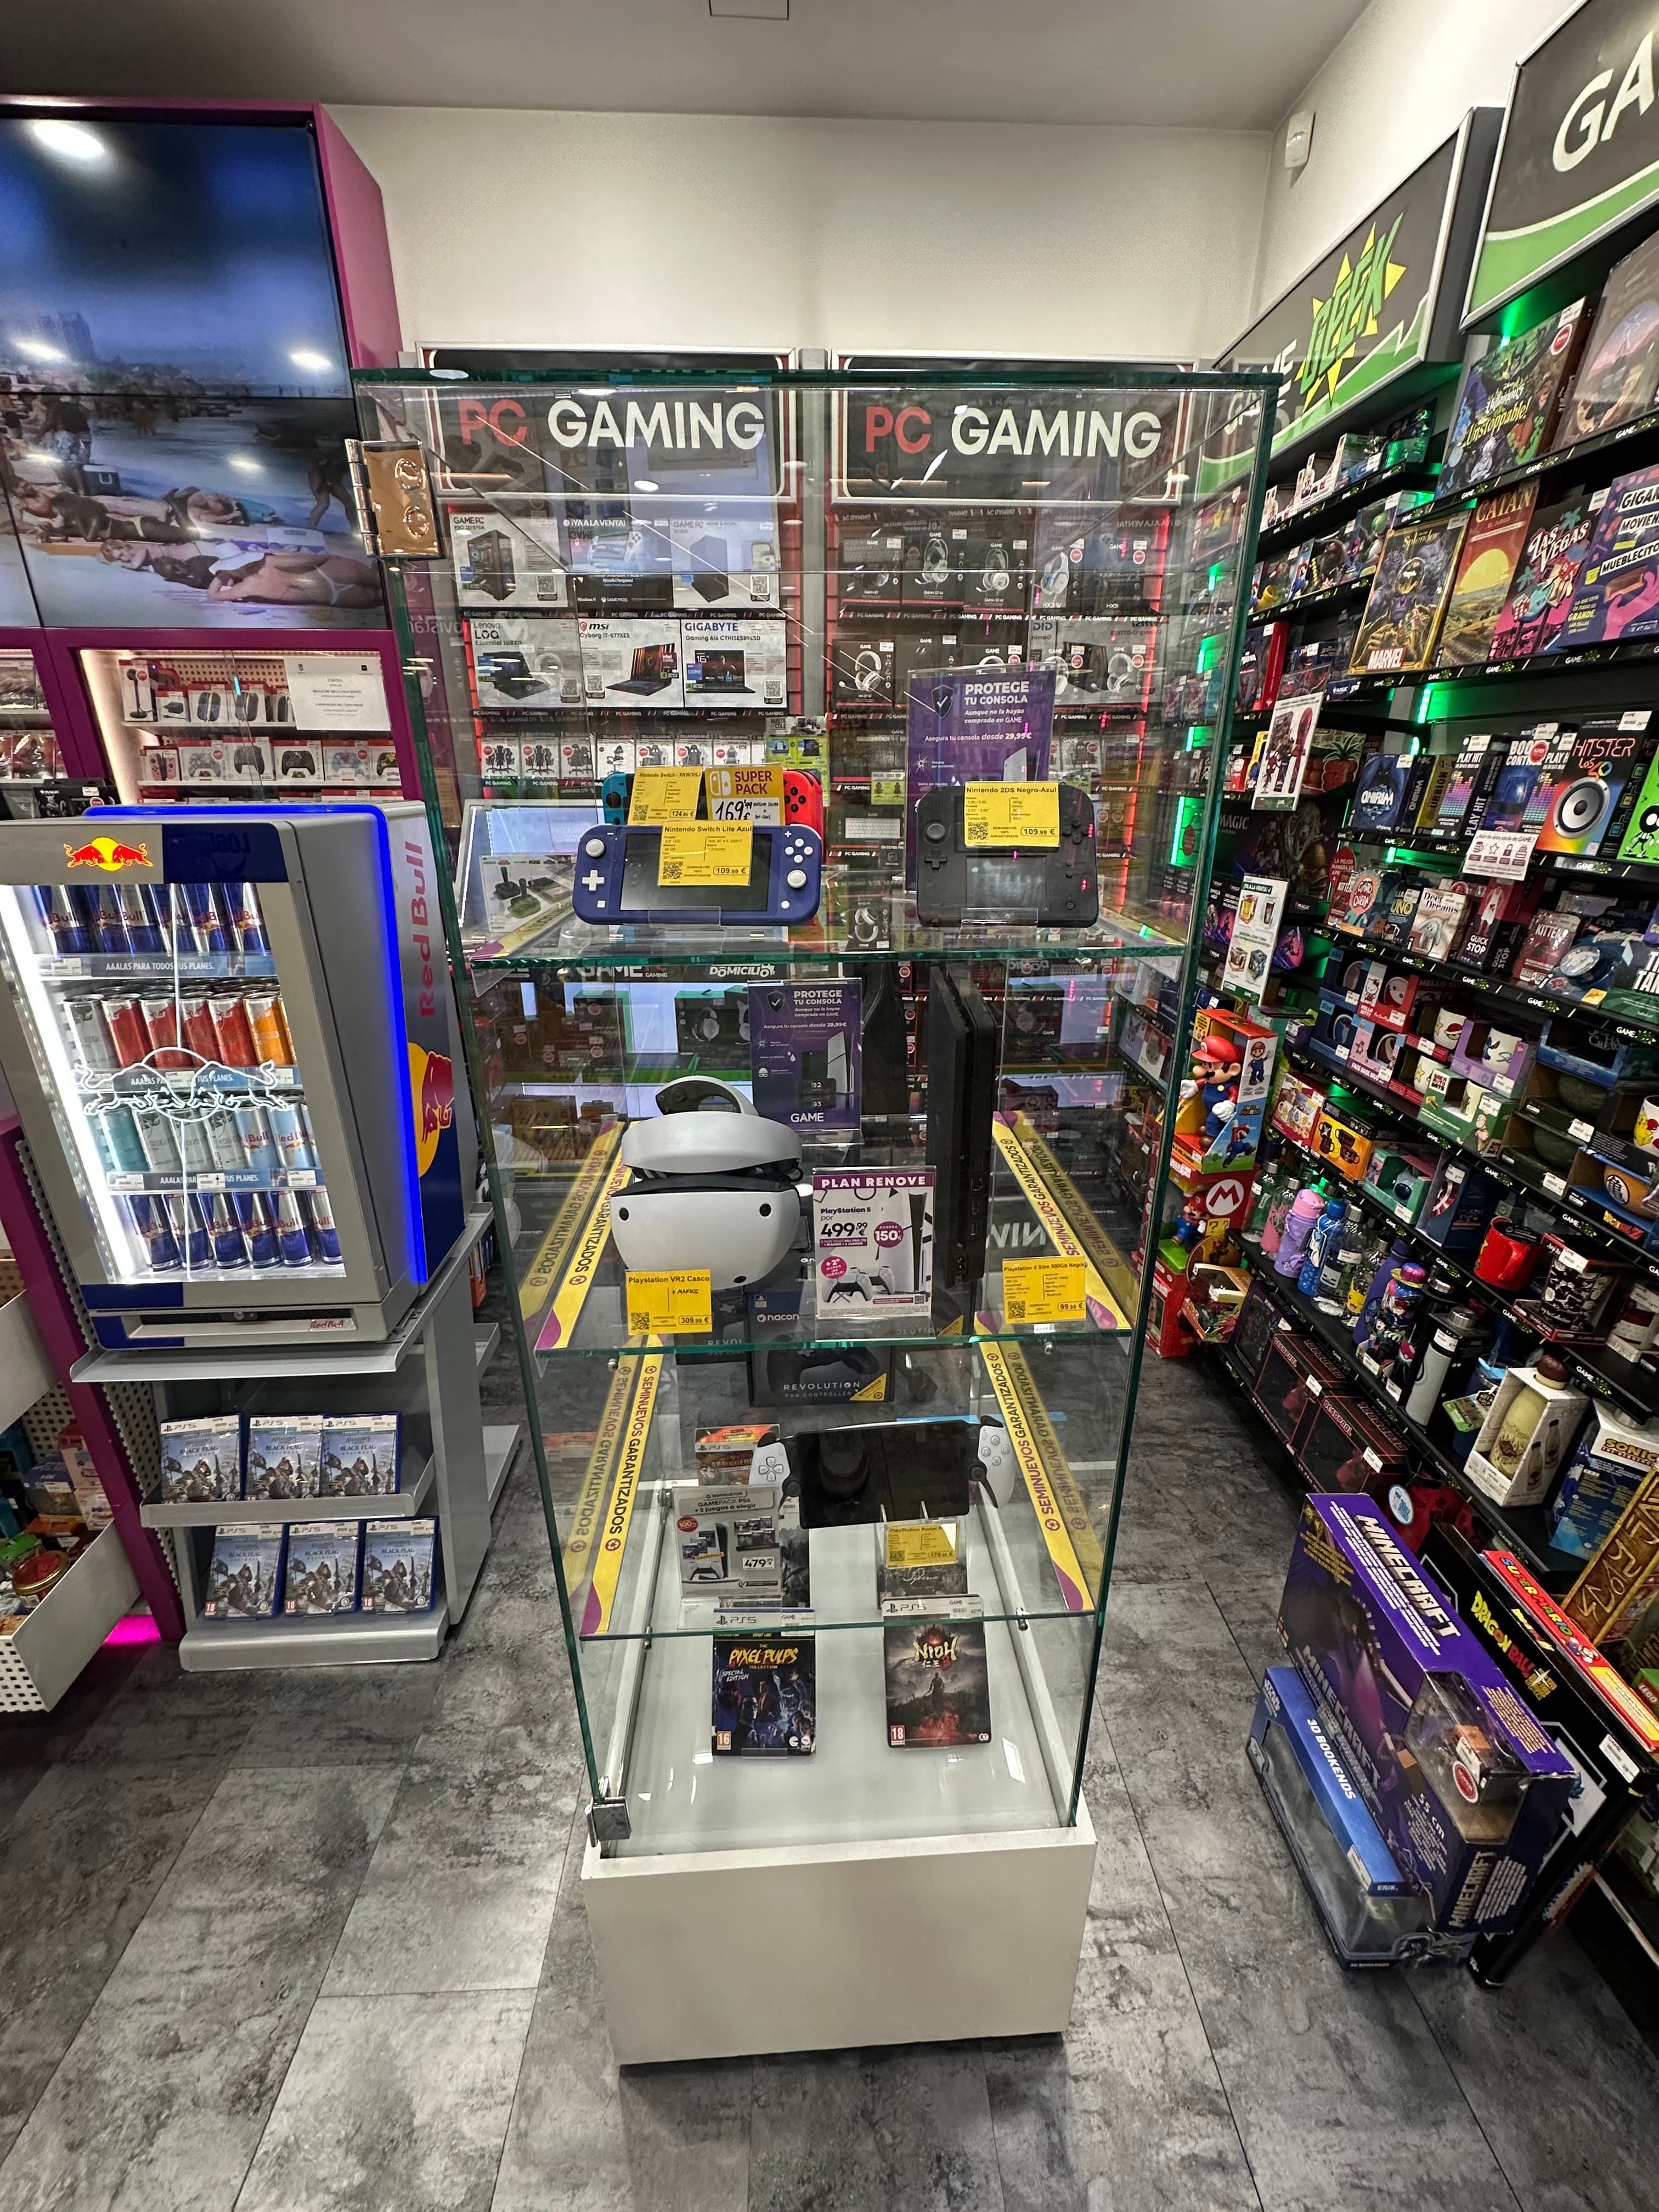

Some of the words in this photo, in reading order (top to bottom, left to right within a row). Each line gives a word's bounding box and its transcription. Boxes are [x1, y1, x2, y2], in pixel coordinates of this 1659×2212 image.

[459, 399, 527, 447] PC
[548, 399, 765, 449] GAMING
[1467, 396, 1532, 449] Unstoppable!
[865, 406, 932, 453] PC
[951, 408, 1161, 458] GAMING
[1615, 426, 1637, 439] GAME
[1526, 462, 1543, 475] GAME
[1476, 488, 1534, 523] CATAN
[473, 621, 500, 629] Lenovo
[589, 623, 610, 631] msi
[685, 622, 738, 631] GIGABYTE
[475, 630, 500, 640] LOQ
[1367, 647, 1406, 669] MARVEL
[964, 681, 1029, 695] PROTEGE
[964, 697, 977, 706] TU
[979, 695, 1029, 705] CONSOLA
[1005, 732, 1032, 741] 29,99€
[1572, 737, 1636, 757] HITSTER
[1457, 753, 1472, 763] PLAY
[1472, 752, 1484, 762] HIT
[735, 770, 772, 783] SUPER
[736, 783, 769, 795] PACK
[1361, 790, 1394, 805] ONIRIM
[1576, 862, 1594, 871] GAME
[405, 840, 428, 927] Bull
[1470, 934, 1489, 946] QUICK
[1465, 941, 1487, 955] STOP
[133, 962, 151, 970] PARA
[152, 962, 174, 970] TODOS
[189, 962, 215, 970] PLANES.
[411, 934, 437, 1017] Red
[1463, 977, 1476, 985] GAME
[794, 990, 843, 998] PROTEGE
[1527, 997, 1544, 1008] GAME
[1616, 1026, 1637, 1039] GAME
[791, 1112, 824, 1122] GAME
[1010, 1145, 1047, 1200] GARANTIZADOS
[821, 1178, 861, 1188] PLAN
[866, 1176, 926, 1187] RENOVE
[1037, 1201, 1080, 1256] SEMINUEVOS
[874, 1230, 898, 1242] 150
[768, 1312, 799, 1321] nacon
[1576, 1365, 1594, 1383] GAME
[784, 1381, 860, 1391] REVOLUTION
[632, 1376, 654, 1437] SEMINUEVOS
[996, 1362, 1027, 1438] GARANTIZADOS
[180, 1446, 200, 1454] BLACK
[201, 1445, 219, 1453] FLAG
[1605, 1437, 1658, 1462] SONIC
[1017, 1440, 1054, 1515] SEMINUEVOS
[610, 1438, 641, 1534] GARANTIZADOS
[698, 1499, 737, 1508] GAMEPACK
[705, 1505, 729, 1514] juegos
[1354, 1514, 1462, 1637] MINECRAFT
[1500, 1557, 1538, 1600] SUPER
[1534, 1595, 1575, 1637] MARIO
[1470, 1590, 1513, 1654] DRAGON
[1507, 1645, 1536, 1680] BALL
[913, 1635, 960, 1662] NIOH
[729, 1647, 763, 1667] PIXEL
[763, 1647, 799, 1664] PULPS
[721, 1668, 744, 1677] SPECIAL
[726, 1673, 749, 1683] EDITION
[718, 1733, 730, 1745] 16
[891, 1726, 904, 1740] 18
[1307, 1718, 1321, 1736] 3D
[1315, 1735, 1357, 1801] BOOKENDS
[1448, 1850, 1497, 1928] MINECRAFT
